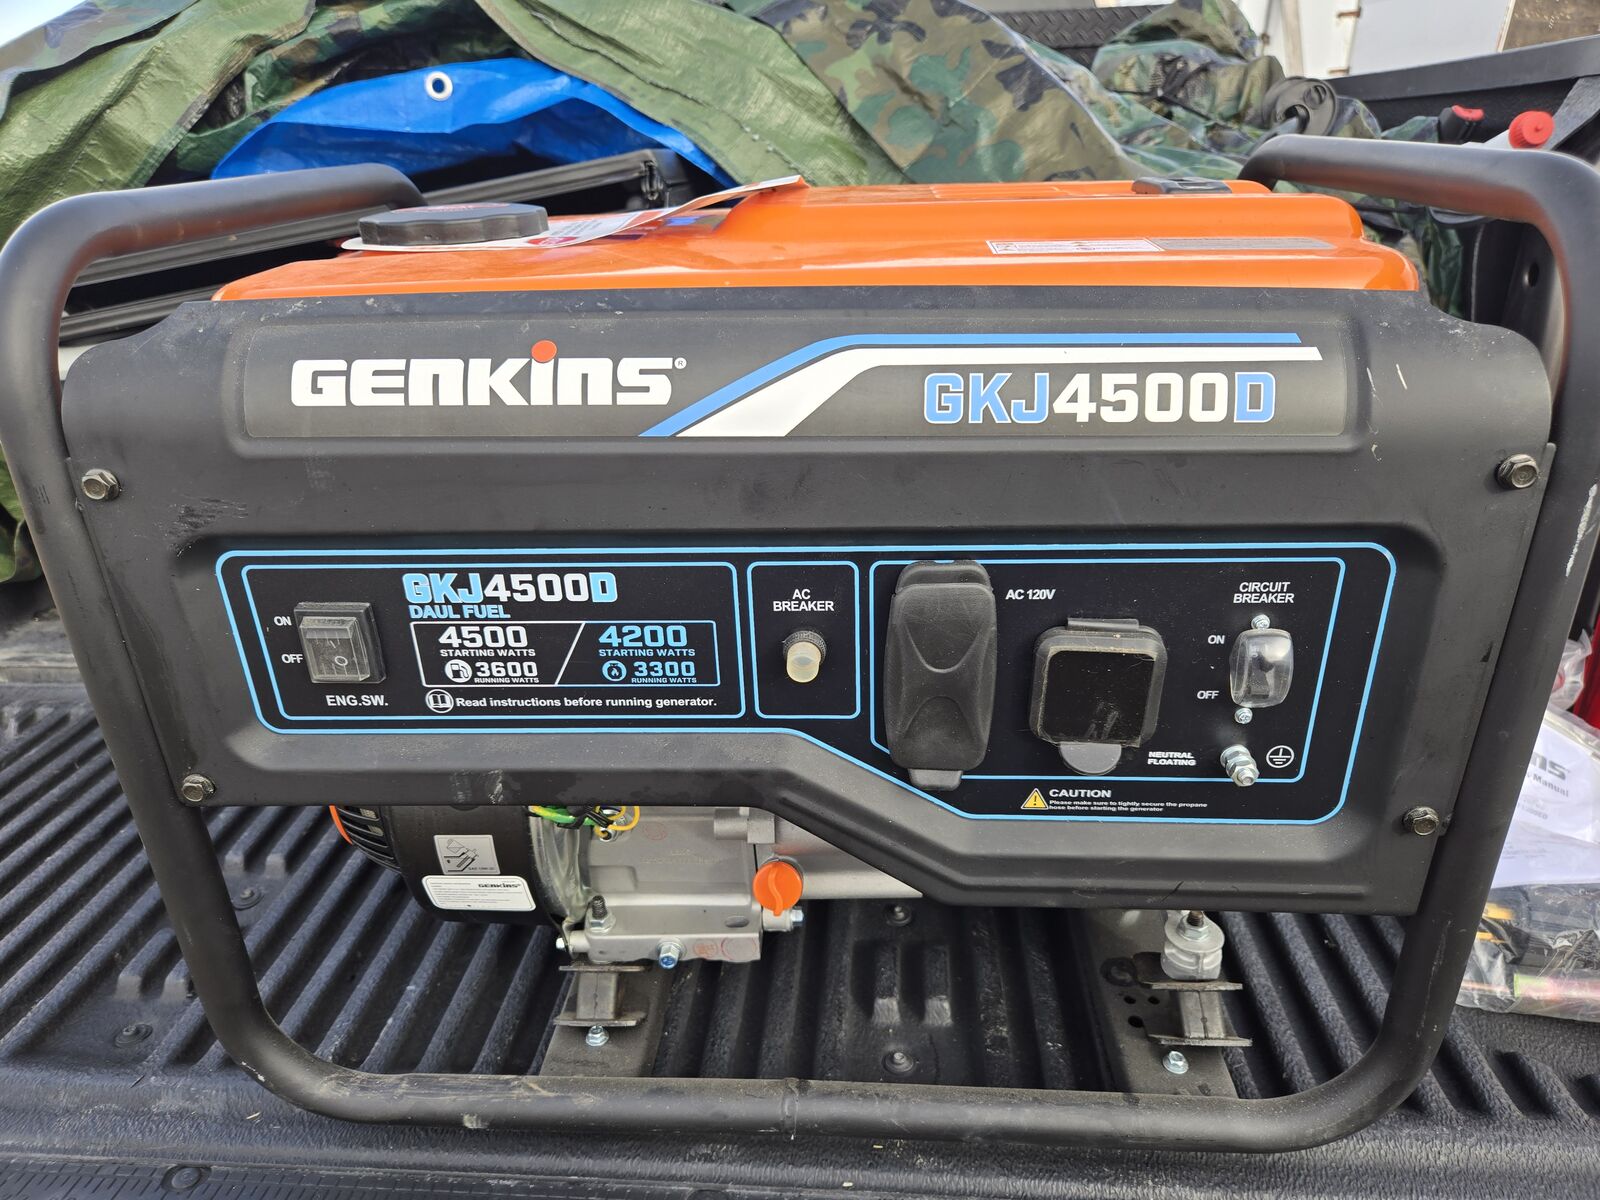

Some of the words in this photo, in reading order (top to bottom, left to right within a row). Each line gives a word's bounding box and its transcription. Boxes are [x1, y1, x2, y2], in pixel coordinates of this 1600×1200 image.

[923, 371, 1277, 425] GKJ4500D
[401, 572, 618, 604] GKJ4500D
[1239, 582, 1291, 593] CIRCUIT
[792, 589, 811, 600] AC
[1005, 589, 1025, 600] AC
[1026, 589, 1056, 600] 120V
[1232, 593, 1295, 604] BREAKER
[408, 605, 461, 619] DAUL
[462, 605, 512, 619] FUEL
[772, 601, 835, 612] BREAKER
[273, 616, 292, 626] ON
[438, 626, 528, 648] 4500
[598, 625, 688, 648] 4200
[1207, 635, 1226, 645] ON
[439, 648, 496, 658] STARTING
[498, 648, 536, 658] WATTS
[598, 649, 654, 657] STARTING
[656, 649, 696, 657] WATTS
[281, 654, 304, 664] OFF
[474, 662, 538, 677] 3600
[633, 662, 696, 677] 3300
[473, 677, 510, 685] RUNNING
[511, 677, 541, 685] WATTS
[631, 677, 667, 685] RUNNING
[669, 677, 698, 685] WATTS
[325, 695, 389, 707] ENG.SW.
[1196, 691, 1220, 700] OFF
[455, 698, 488, 707] Read
[489, 698, 562, 707] instructions
[563, 697, 603, 707] before
[605, 698, 653, 709] running
[655, 698, 717, 709] generator.
[1048, 789, 1112, 798] CAUTION
